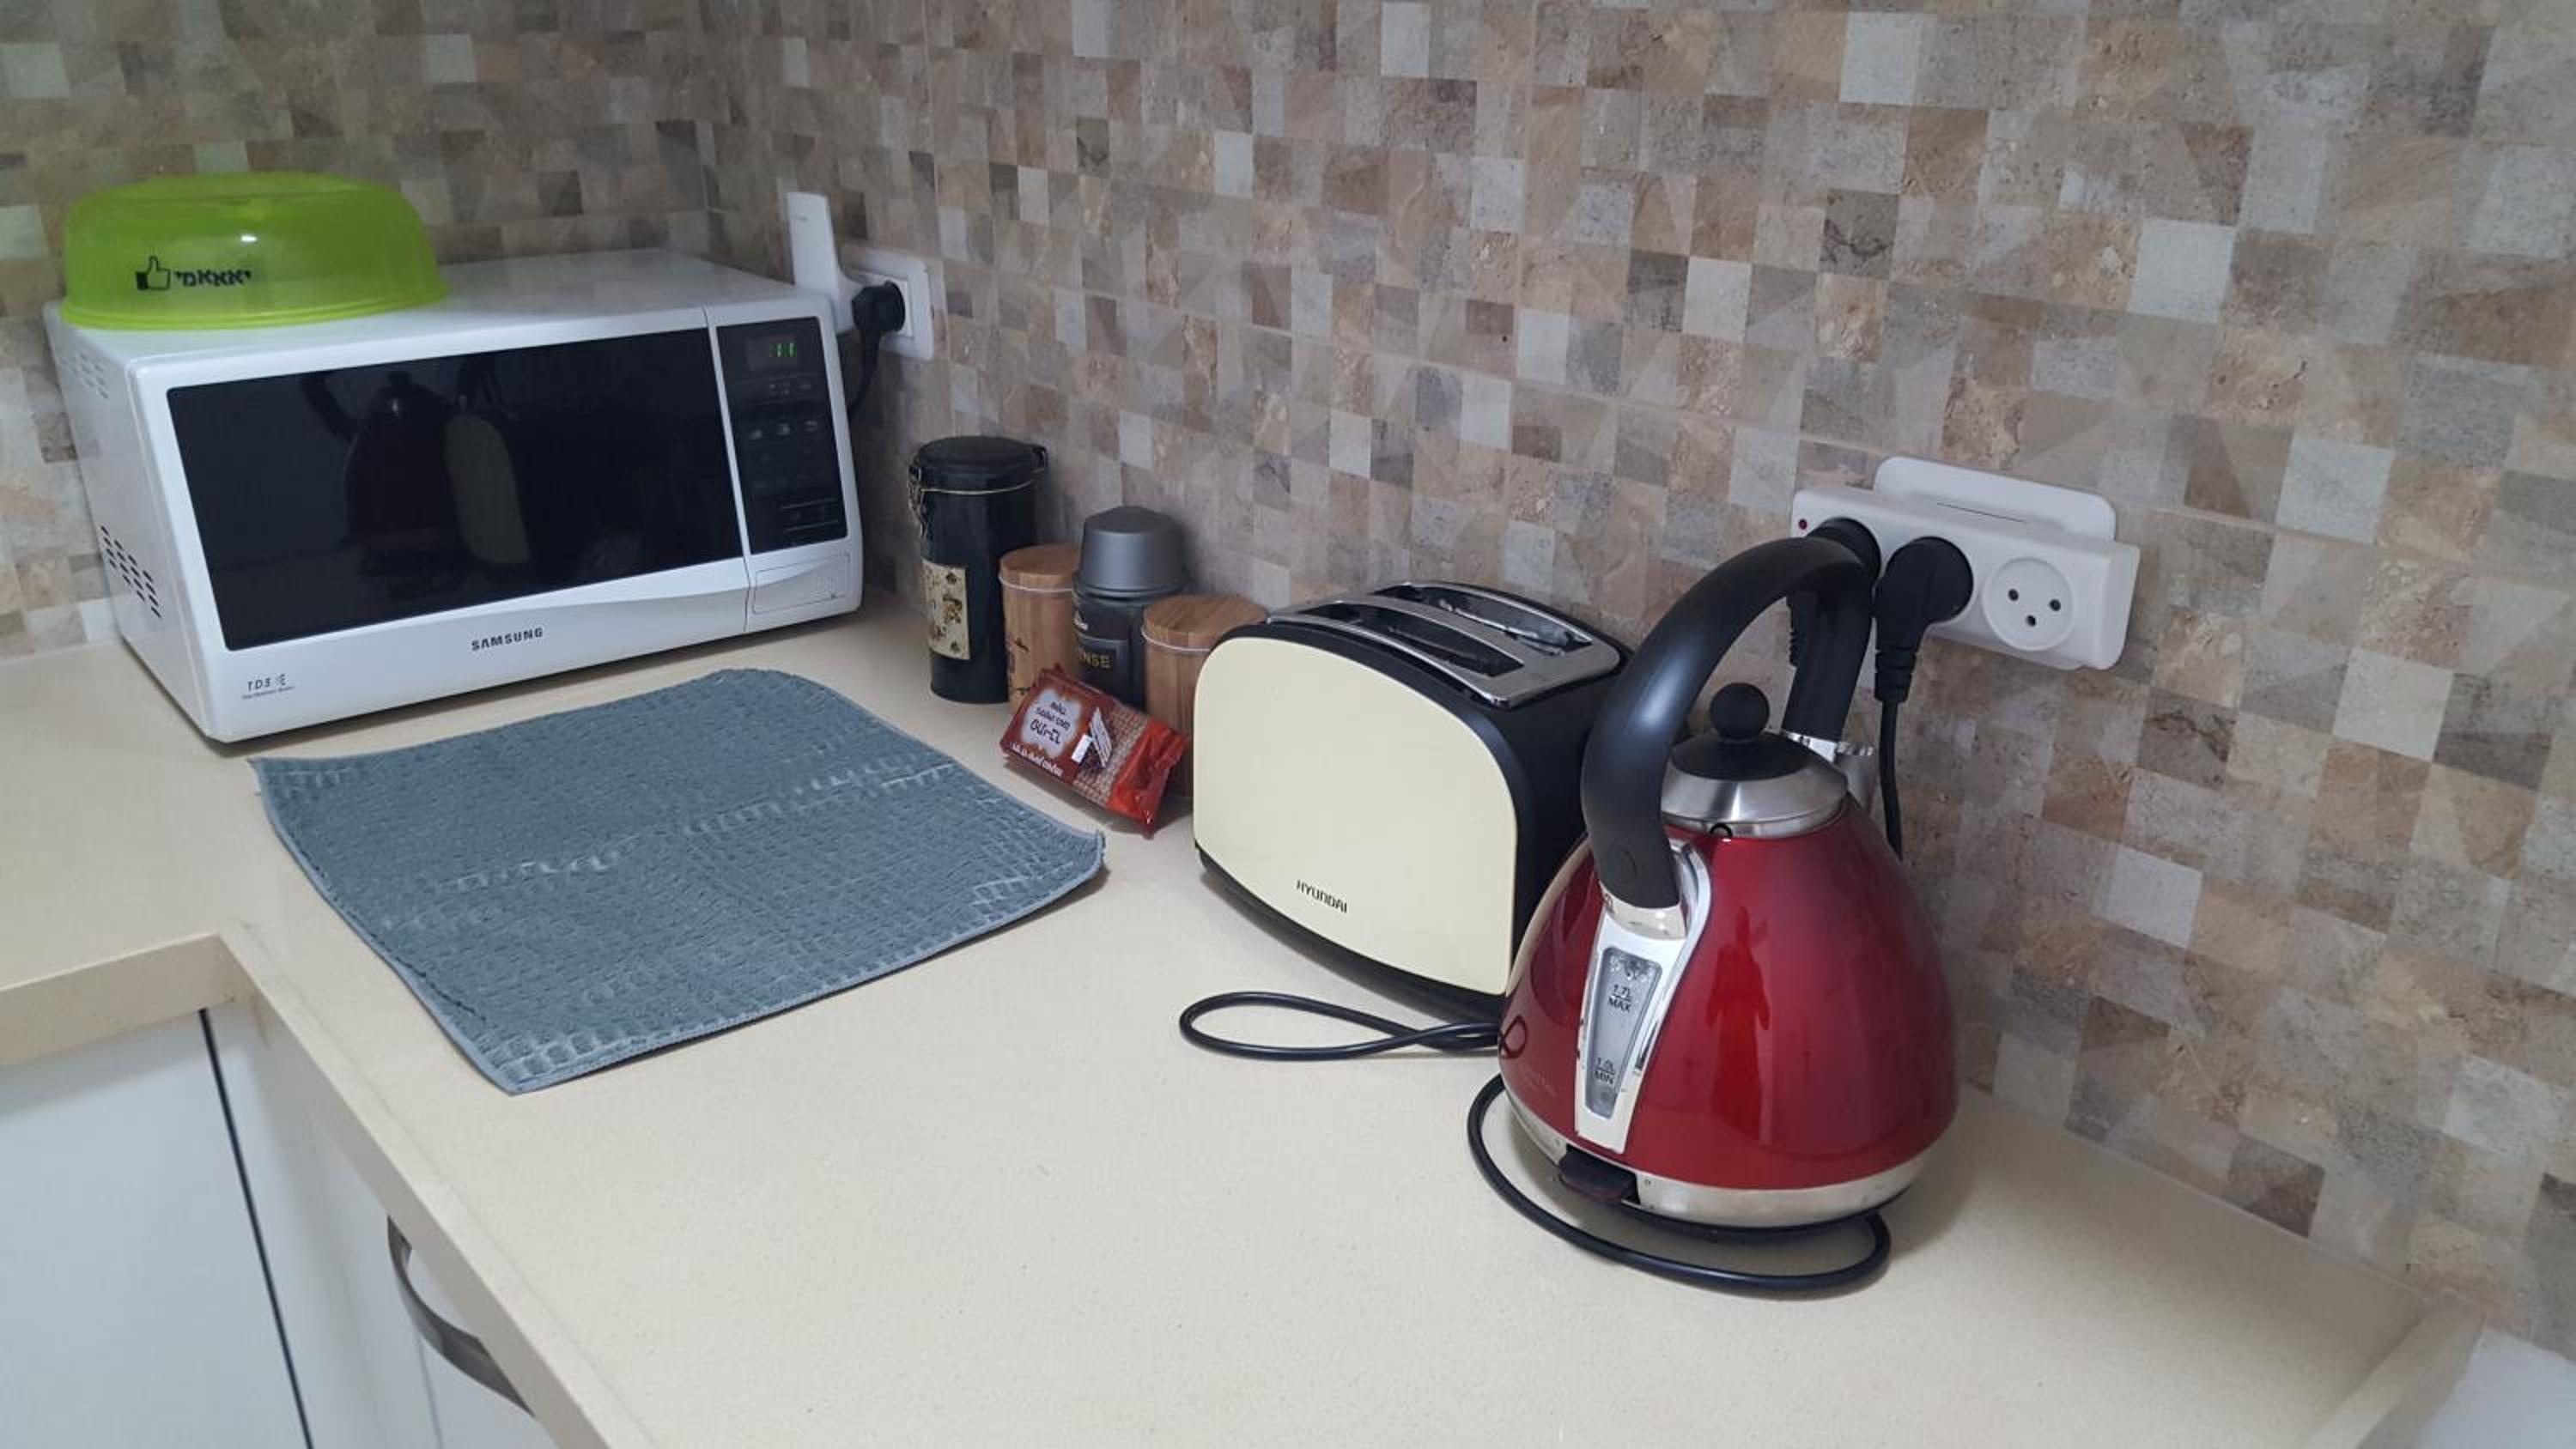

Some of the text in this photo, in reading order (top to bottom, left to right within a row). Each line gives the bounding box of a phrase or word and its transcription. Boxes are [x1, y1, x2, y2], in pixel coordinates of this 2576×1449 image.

[471, 627, 544, 652] SAMSUNG
[1296, 870, 1347, 914] HYUNDAI
[1608, 997, 1632, 1013] MAX
[1595, 1070, 1614, 1085] MIN
